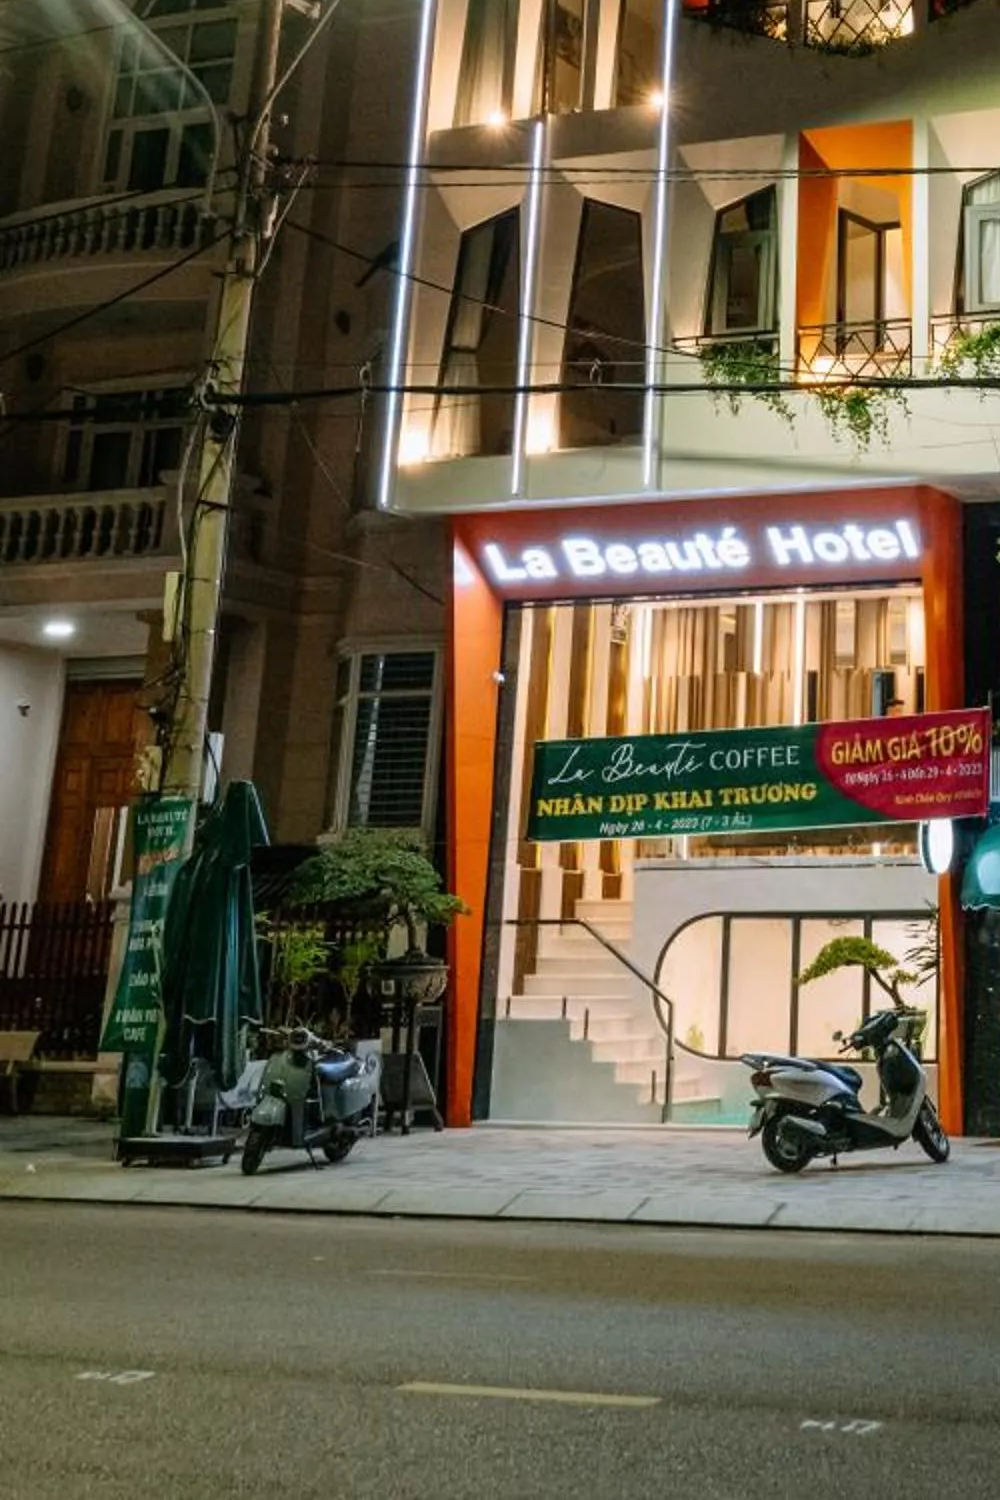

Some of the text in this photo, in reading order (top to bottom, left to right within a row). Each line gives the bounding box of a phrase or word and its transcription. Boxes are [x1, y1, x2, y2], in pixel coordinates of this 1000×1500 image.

[484, 519, 922, 581] La Beauté Hotel
[709, 745, 800, 771] COFFEE
[537, 793, 603, 816] NHÂN
[609, 793, 649, 817] DỊP
[653, 789, 713, 810] KHAI
